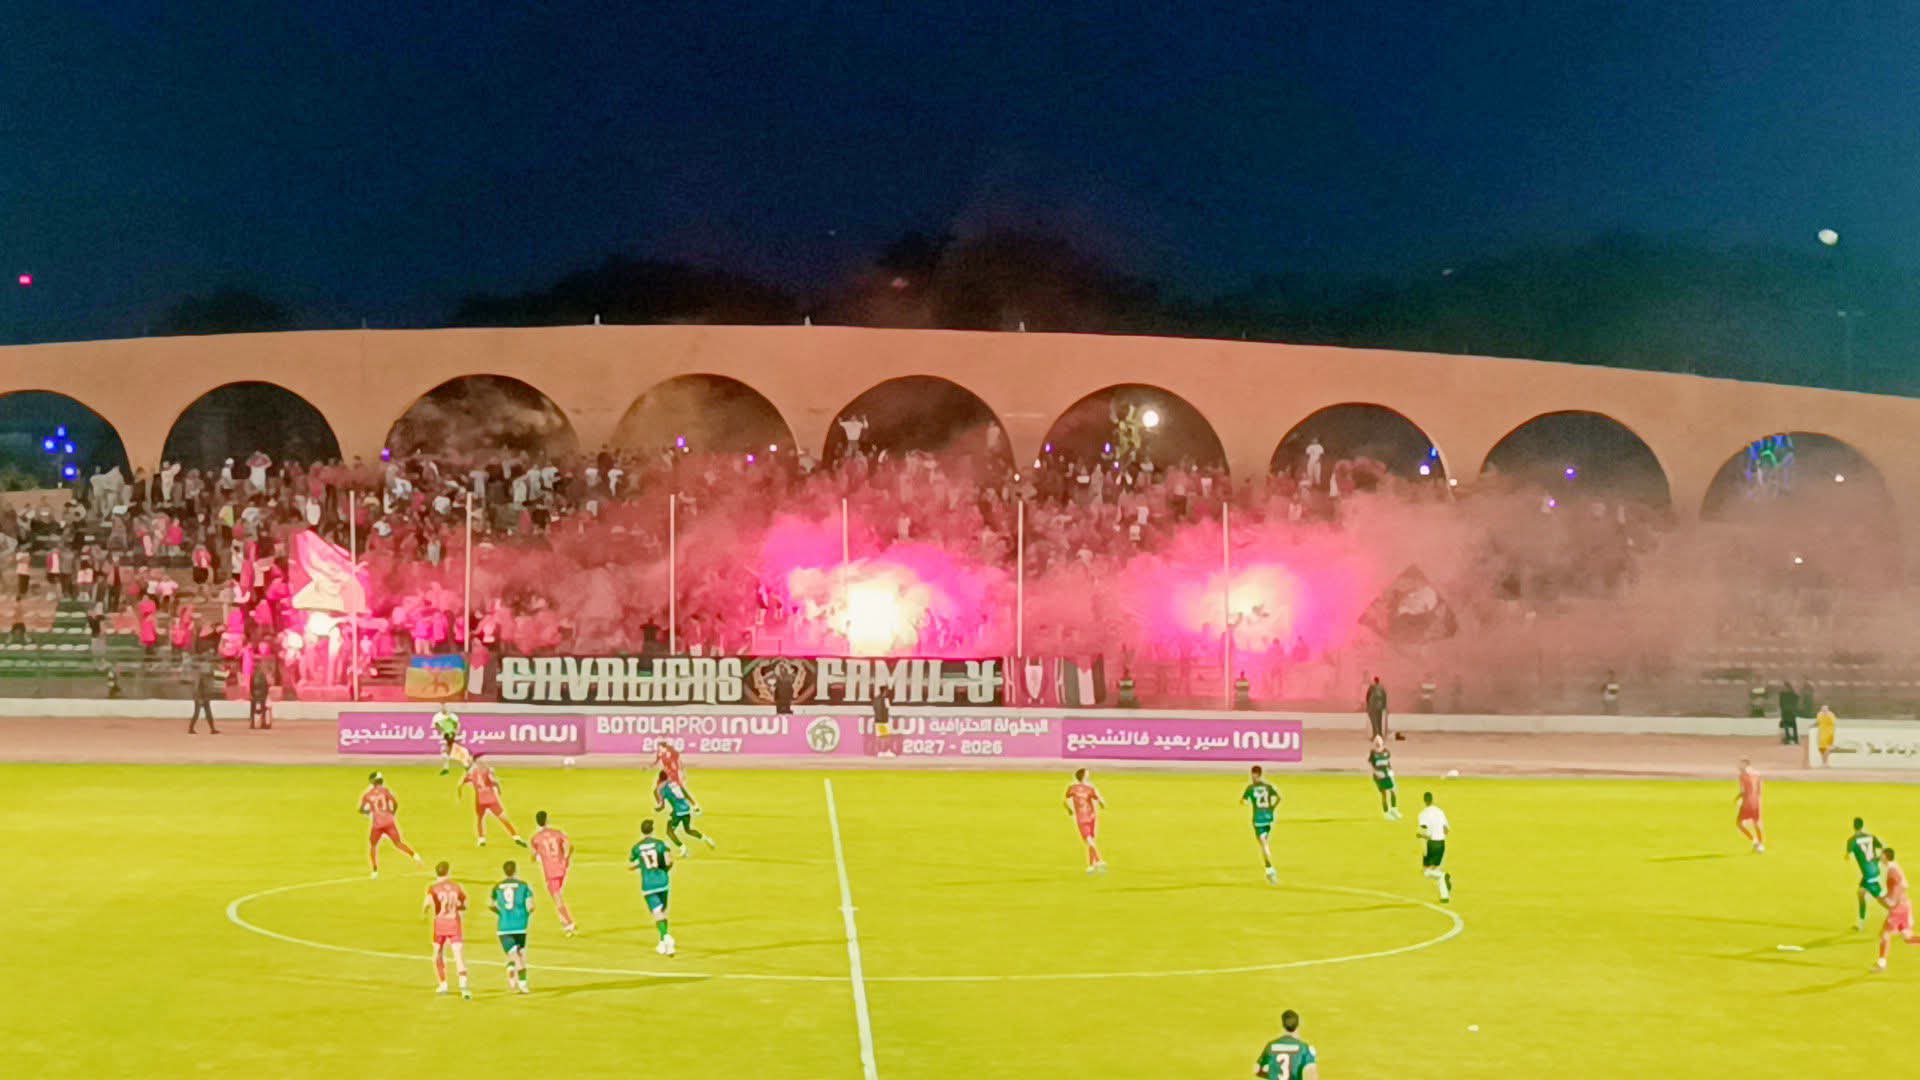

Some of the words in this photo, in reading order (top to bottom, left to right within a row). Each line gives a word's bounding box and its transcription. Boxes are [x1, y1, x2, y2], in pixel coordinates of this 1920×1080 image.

[814, 657, 1003, 703] FAMILY
[340, 722, 425, 745] فالتشجيع
[1066, 728, 1150, 752] فالتشجيع
[1154, 732, 1191, 751] بعيد
[1193, 733, 1230, 750] سير
[503, 887, 514, 910] 9
